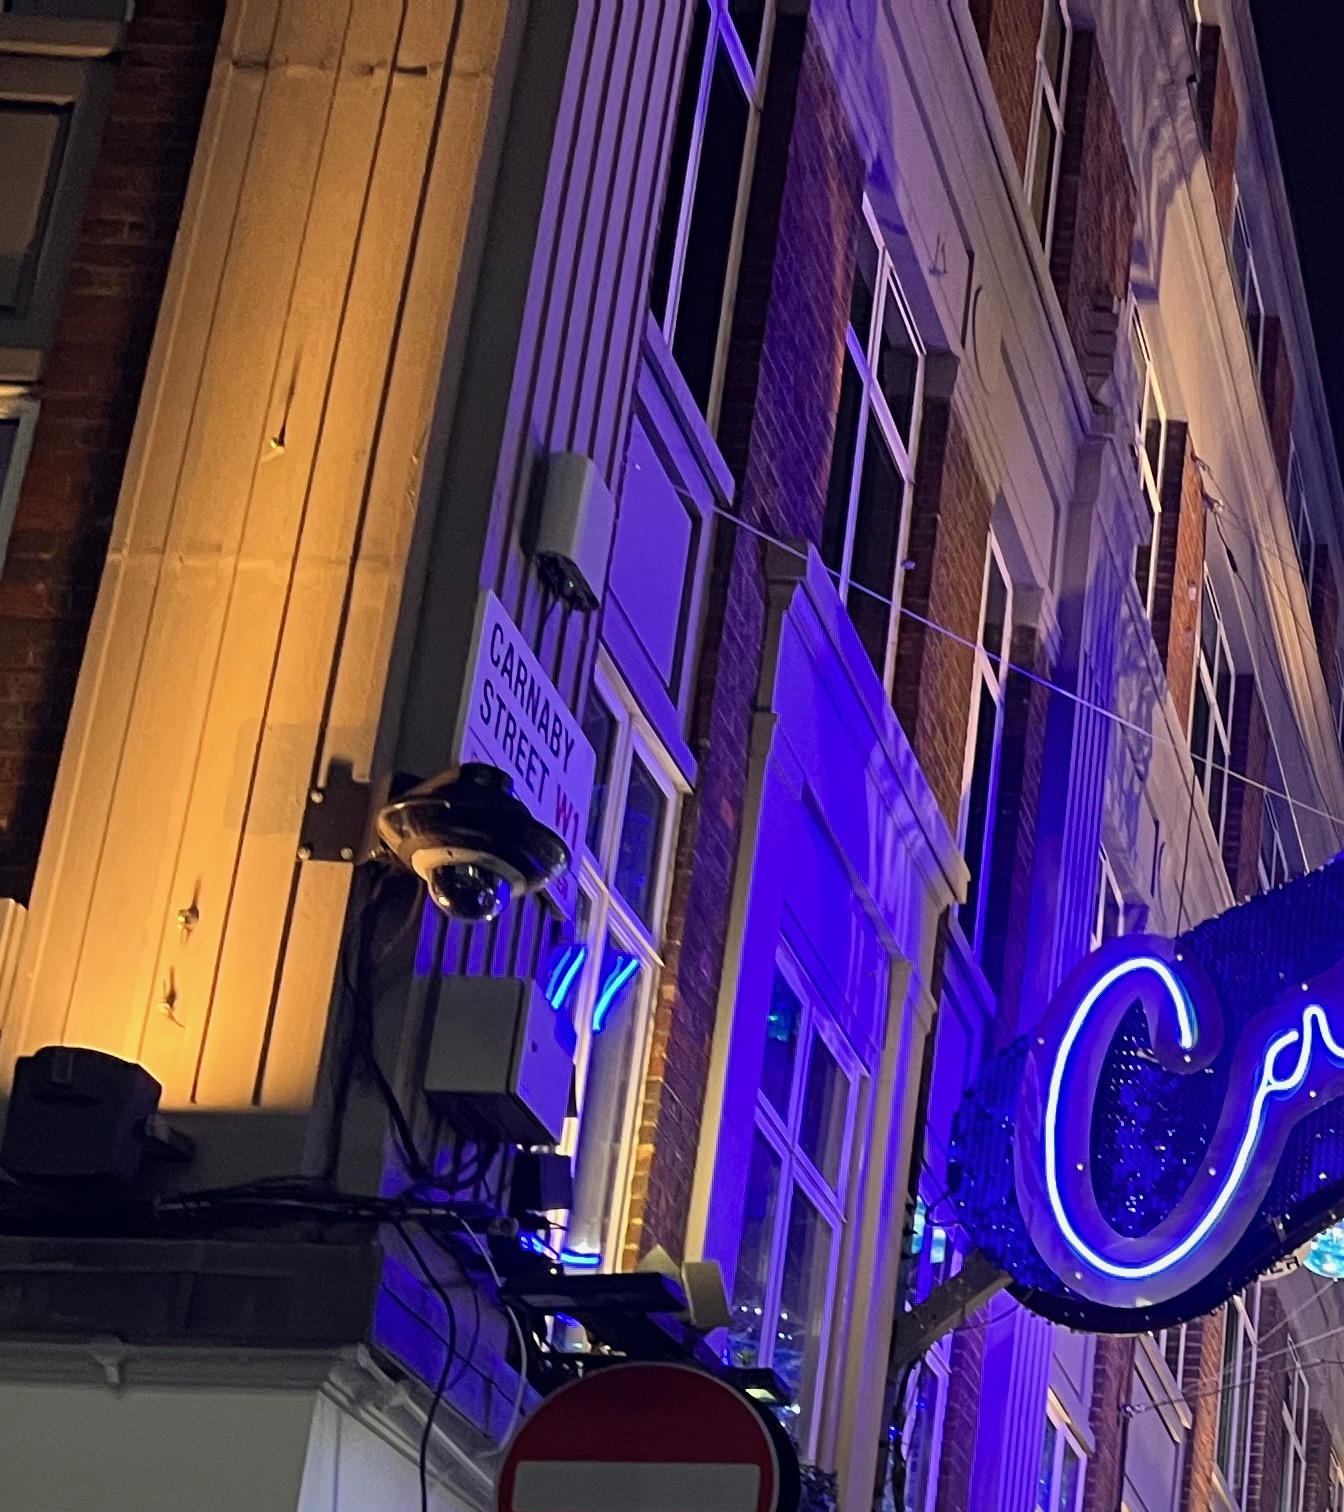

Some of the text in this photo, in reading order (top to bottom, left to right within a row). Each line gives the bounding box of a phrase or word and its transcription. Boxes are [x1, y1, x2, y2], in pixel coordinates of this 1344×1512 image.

[480, 678, 580, 850] STREET W1
[489, 622, 576, 774] CARNABY
